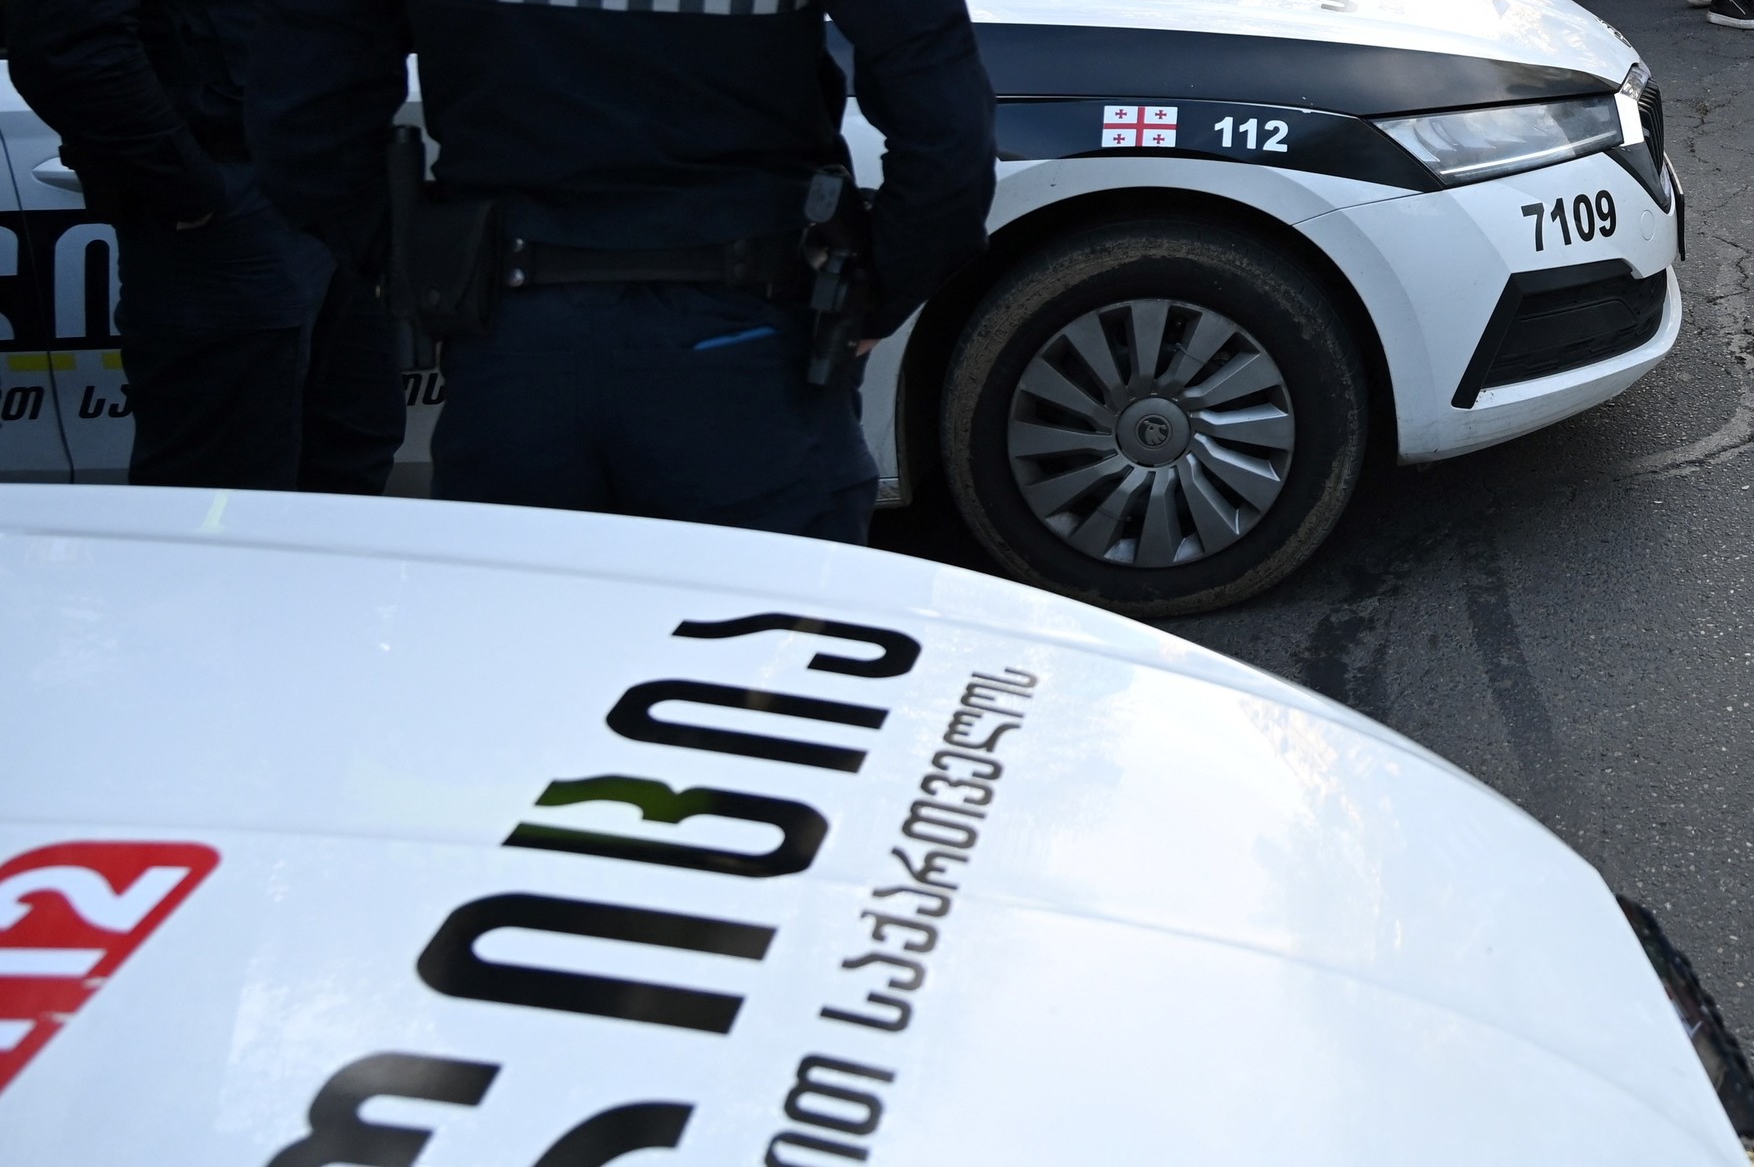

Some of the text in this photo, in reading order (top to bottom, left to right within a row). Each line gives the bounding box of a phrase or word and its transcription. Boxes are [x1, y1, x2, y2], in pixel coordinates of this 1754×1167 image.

[1214, 116, 1289, 153] 112
[1521, 189, 1617, 252] 7109
[819, 666, 1038, 1033] საქართველოს
